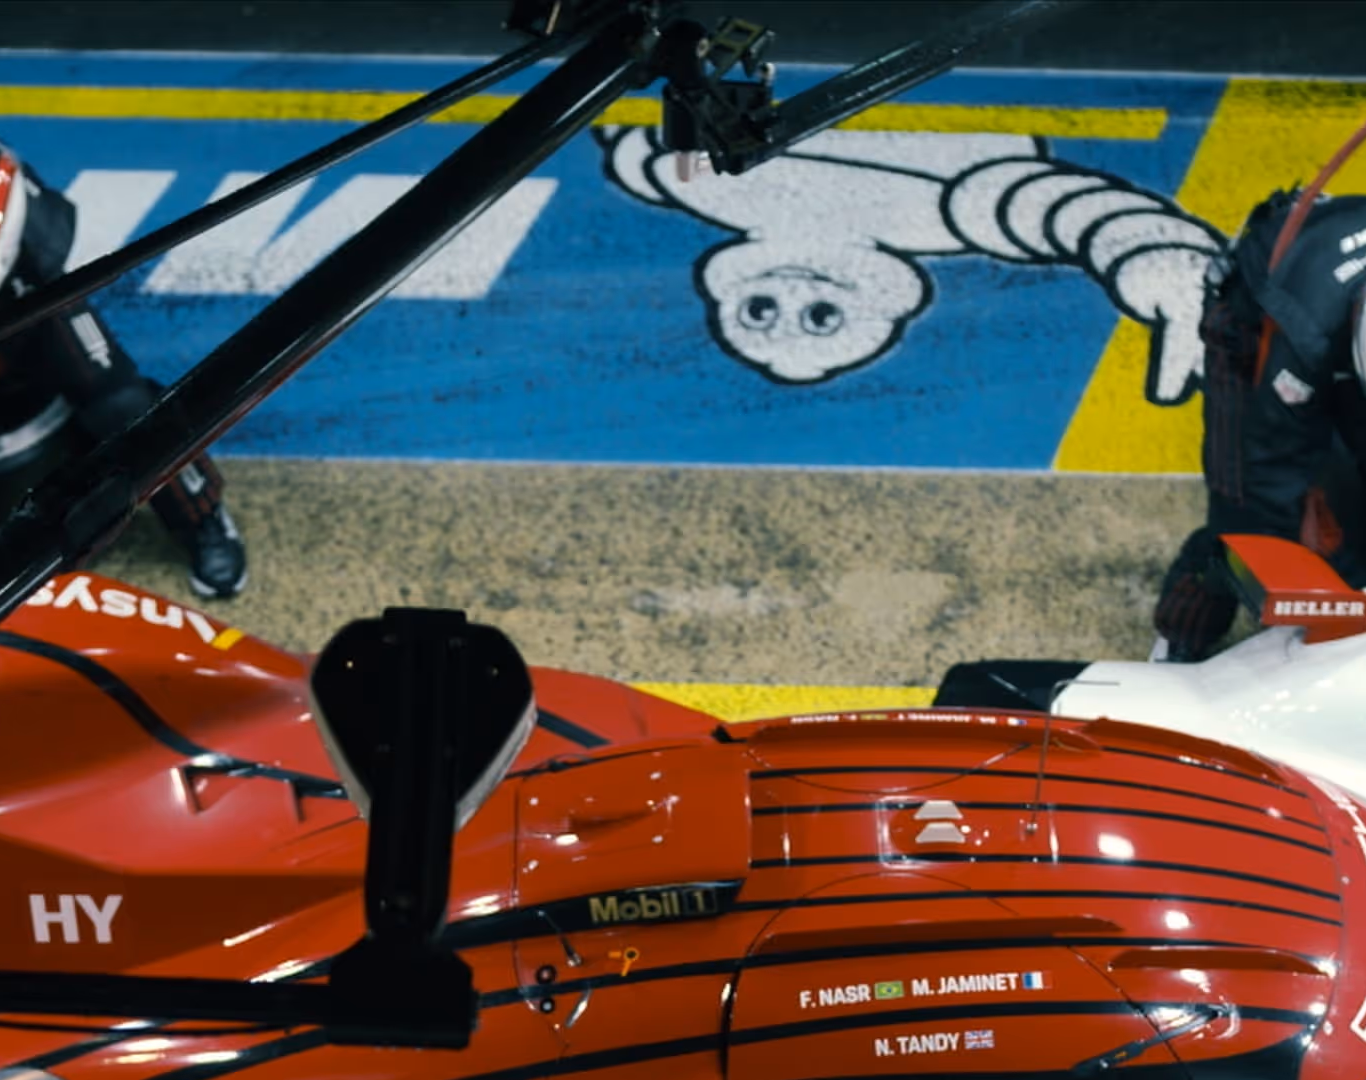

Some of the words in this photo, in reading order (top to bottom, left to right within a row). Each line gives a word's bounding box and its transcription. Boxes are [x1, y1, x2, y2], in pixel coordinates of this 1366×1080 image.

[1275, 600, 1364, 617] HELLER
[30, 894, 121, 943] HY
[590, 893, 679, 923] Mobil
[693, 891, 705, 913] 1
[801, 989, 814, 1008] F.
[819, 985, 870, 1004] NASR
[911, 977, 931, 996] M.
[937, 973, 1018, 994] JAMINET
[875, 1037, 894, 1056] N.
[900, 1033, 960, 1054] TANDY
